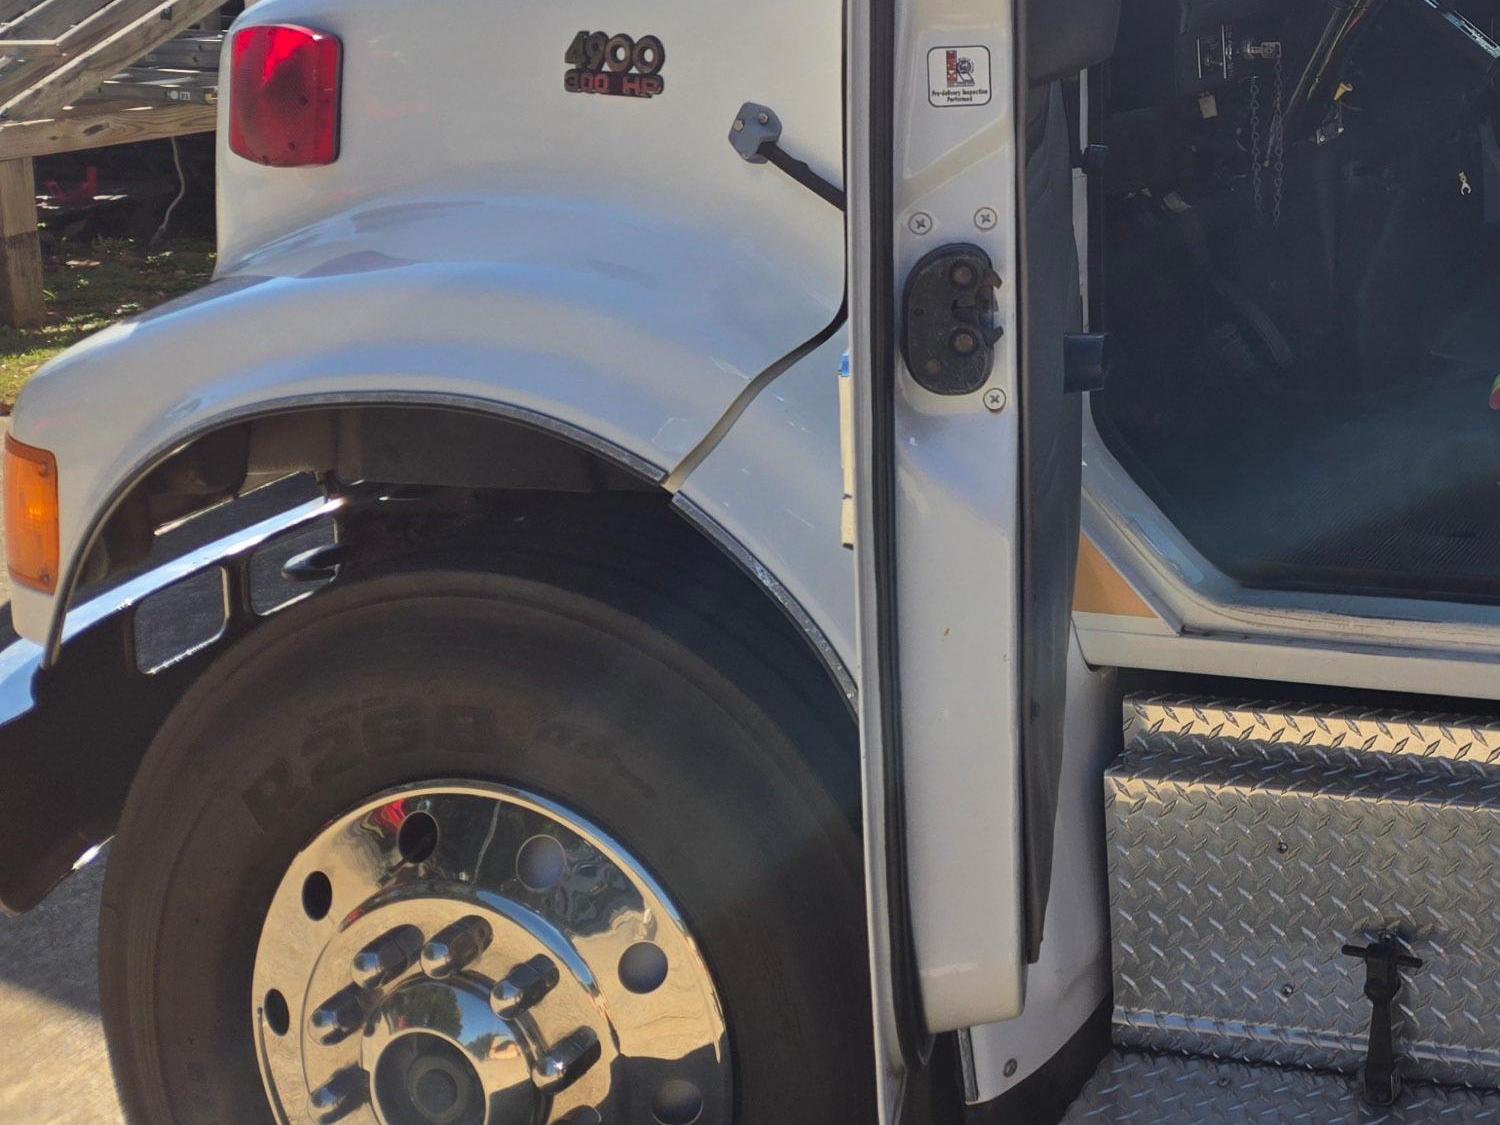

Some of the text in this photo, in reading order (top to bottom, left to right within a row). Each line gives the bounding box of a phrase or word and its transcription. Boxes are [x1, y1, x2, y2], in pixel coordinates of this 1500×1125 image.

[564, 30, 666, 75] 4900
[564, 70, 664, 98] 300 HP
